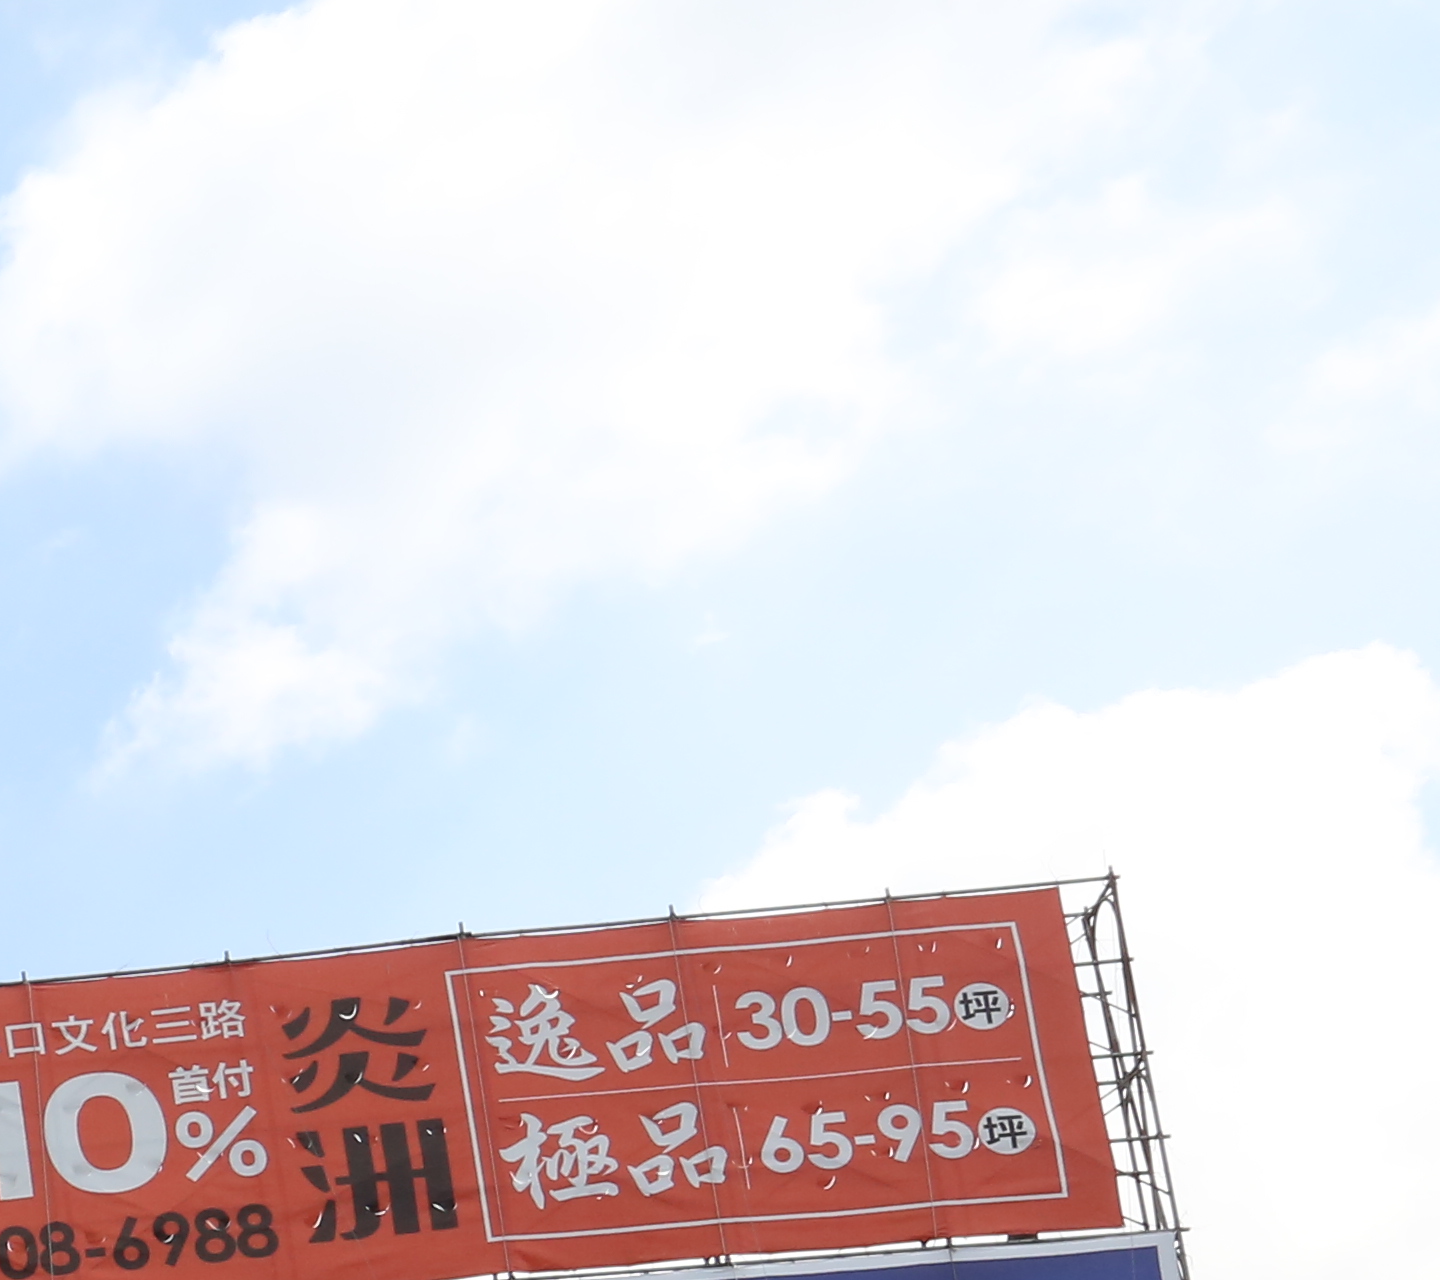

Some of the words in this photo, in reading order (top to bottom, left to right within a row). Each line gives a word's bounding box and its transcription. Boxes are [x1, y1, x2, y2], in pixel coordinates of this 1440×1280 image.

[485, 976, 705, 1080] 逸品
[734, 975, 1009, 1052] 30-55坪
[168, 1059, 254, 1105] 首付
[281, 996, 459, 1244] 炎洲
[499, 1101, 728, 1209] 極品
[760, 1100, 1036, 1173] 65-95坪
